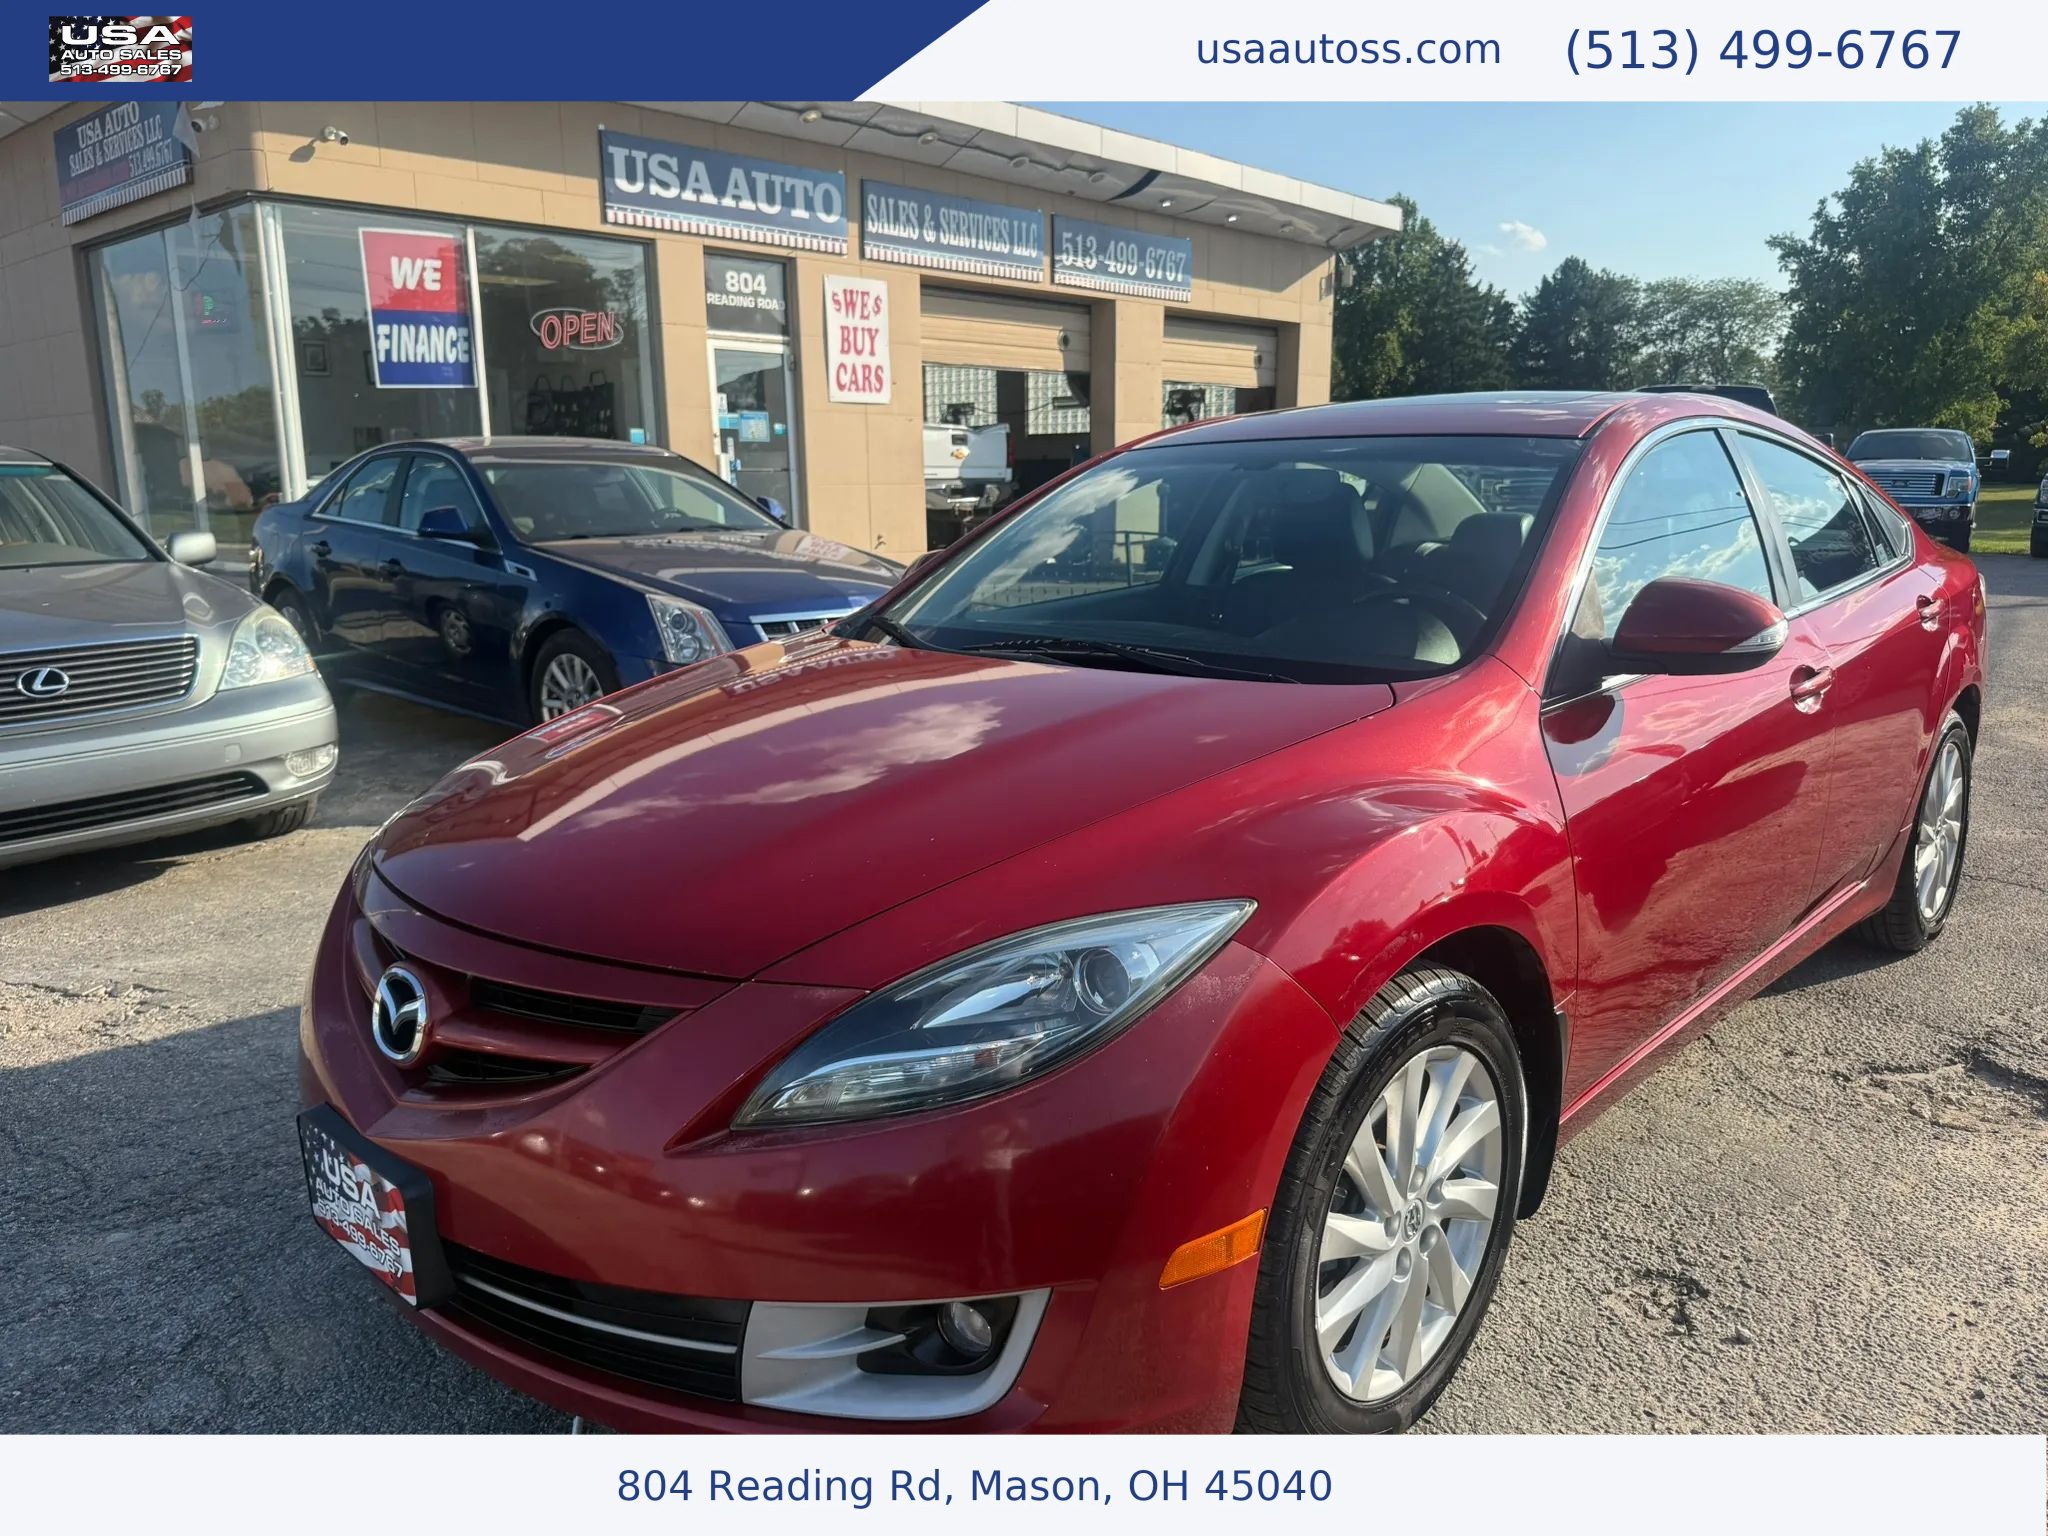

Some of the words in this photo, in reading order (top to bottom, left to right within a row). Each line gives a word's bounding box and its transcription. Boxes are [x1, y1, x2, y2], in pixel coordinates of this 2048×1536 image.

[69, 149, 95, 177] SALES
[102, 121, 145, 163] SERVICES
[144, 114, 163, 145] LLC
[76, 117, 103, 149] USA
[104, 101, 140, 137] AUTO
[607, 145, 718, 205] USA
[721, 167, 843, 224] AUTO
[867, 193, 919, 241] SALES
[922, 206, 937, 243] &
[938, 207, 1010, 253] SERVICES
[1012, 218, 1038, 258] LLC
[390, 255, 443, 292] WE
[1061, 232, 1186, 282] 513-499-6767
[706, 292, 756, 309] READING
[725, 270, 768, 296] 804
[376, 323, 470, 364] FINANCE
[540, 311, 616, 350] OPEN
[839, 325, 880, 357] BUY
[836, 362, 885, 394] CARS
[322, 1148, 380, 1220] USA
[315, 1176, 350, 1215] AUTO
[353, 1204, 402, 1258] SALES
